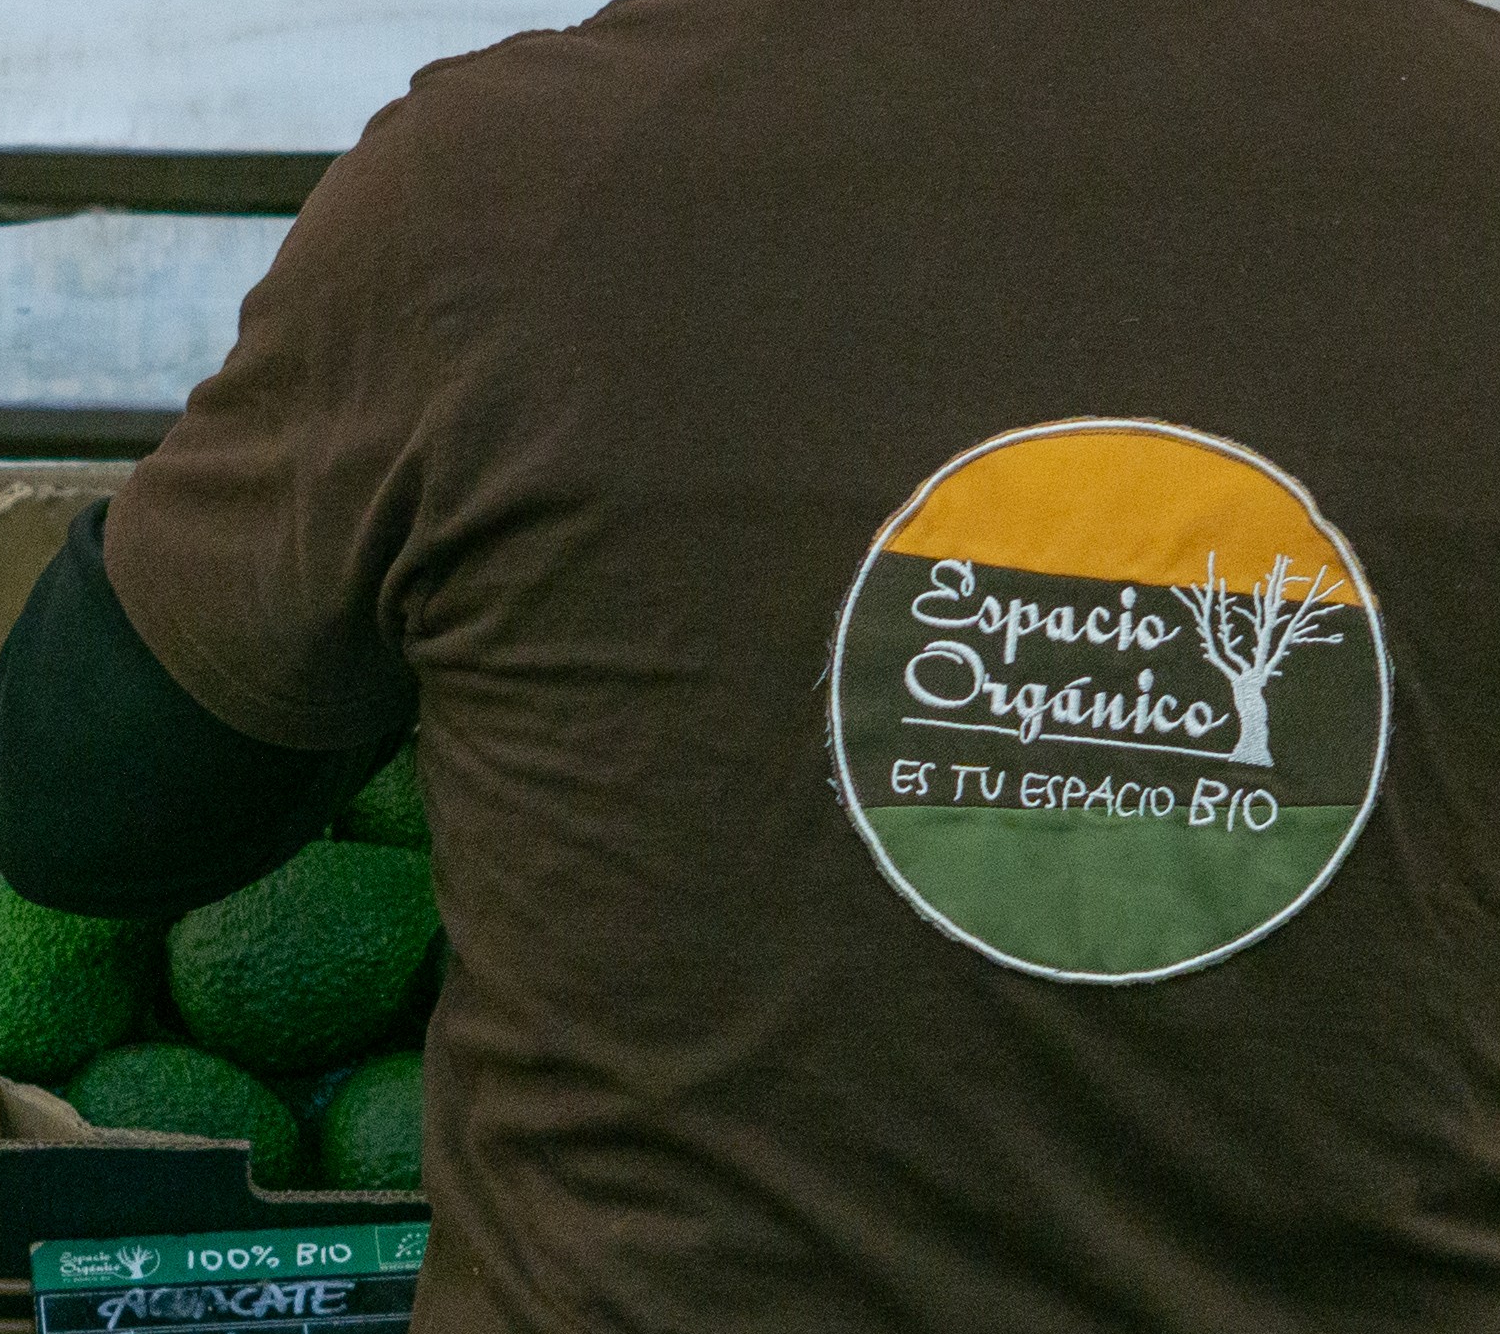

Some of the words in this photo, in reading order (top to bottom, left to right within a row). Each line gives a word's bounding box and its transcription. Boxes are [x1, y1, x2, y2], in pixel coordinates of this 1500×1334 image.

[911, 558, 1182, 665] Espacio
[904, 640, 1230, 744] Orgánico
[891, 759, 936, 796] ES
[951, 764, 1006, 803] TU
[1020, 772, 1175, 819] ESPACIO
[1187, 777, 1279, 833] BIO
[186, 1244, 280, 1270] 100%
[296, 1242, 352, 1267] BIO
